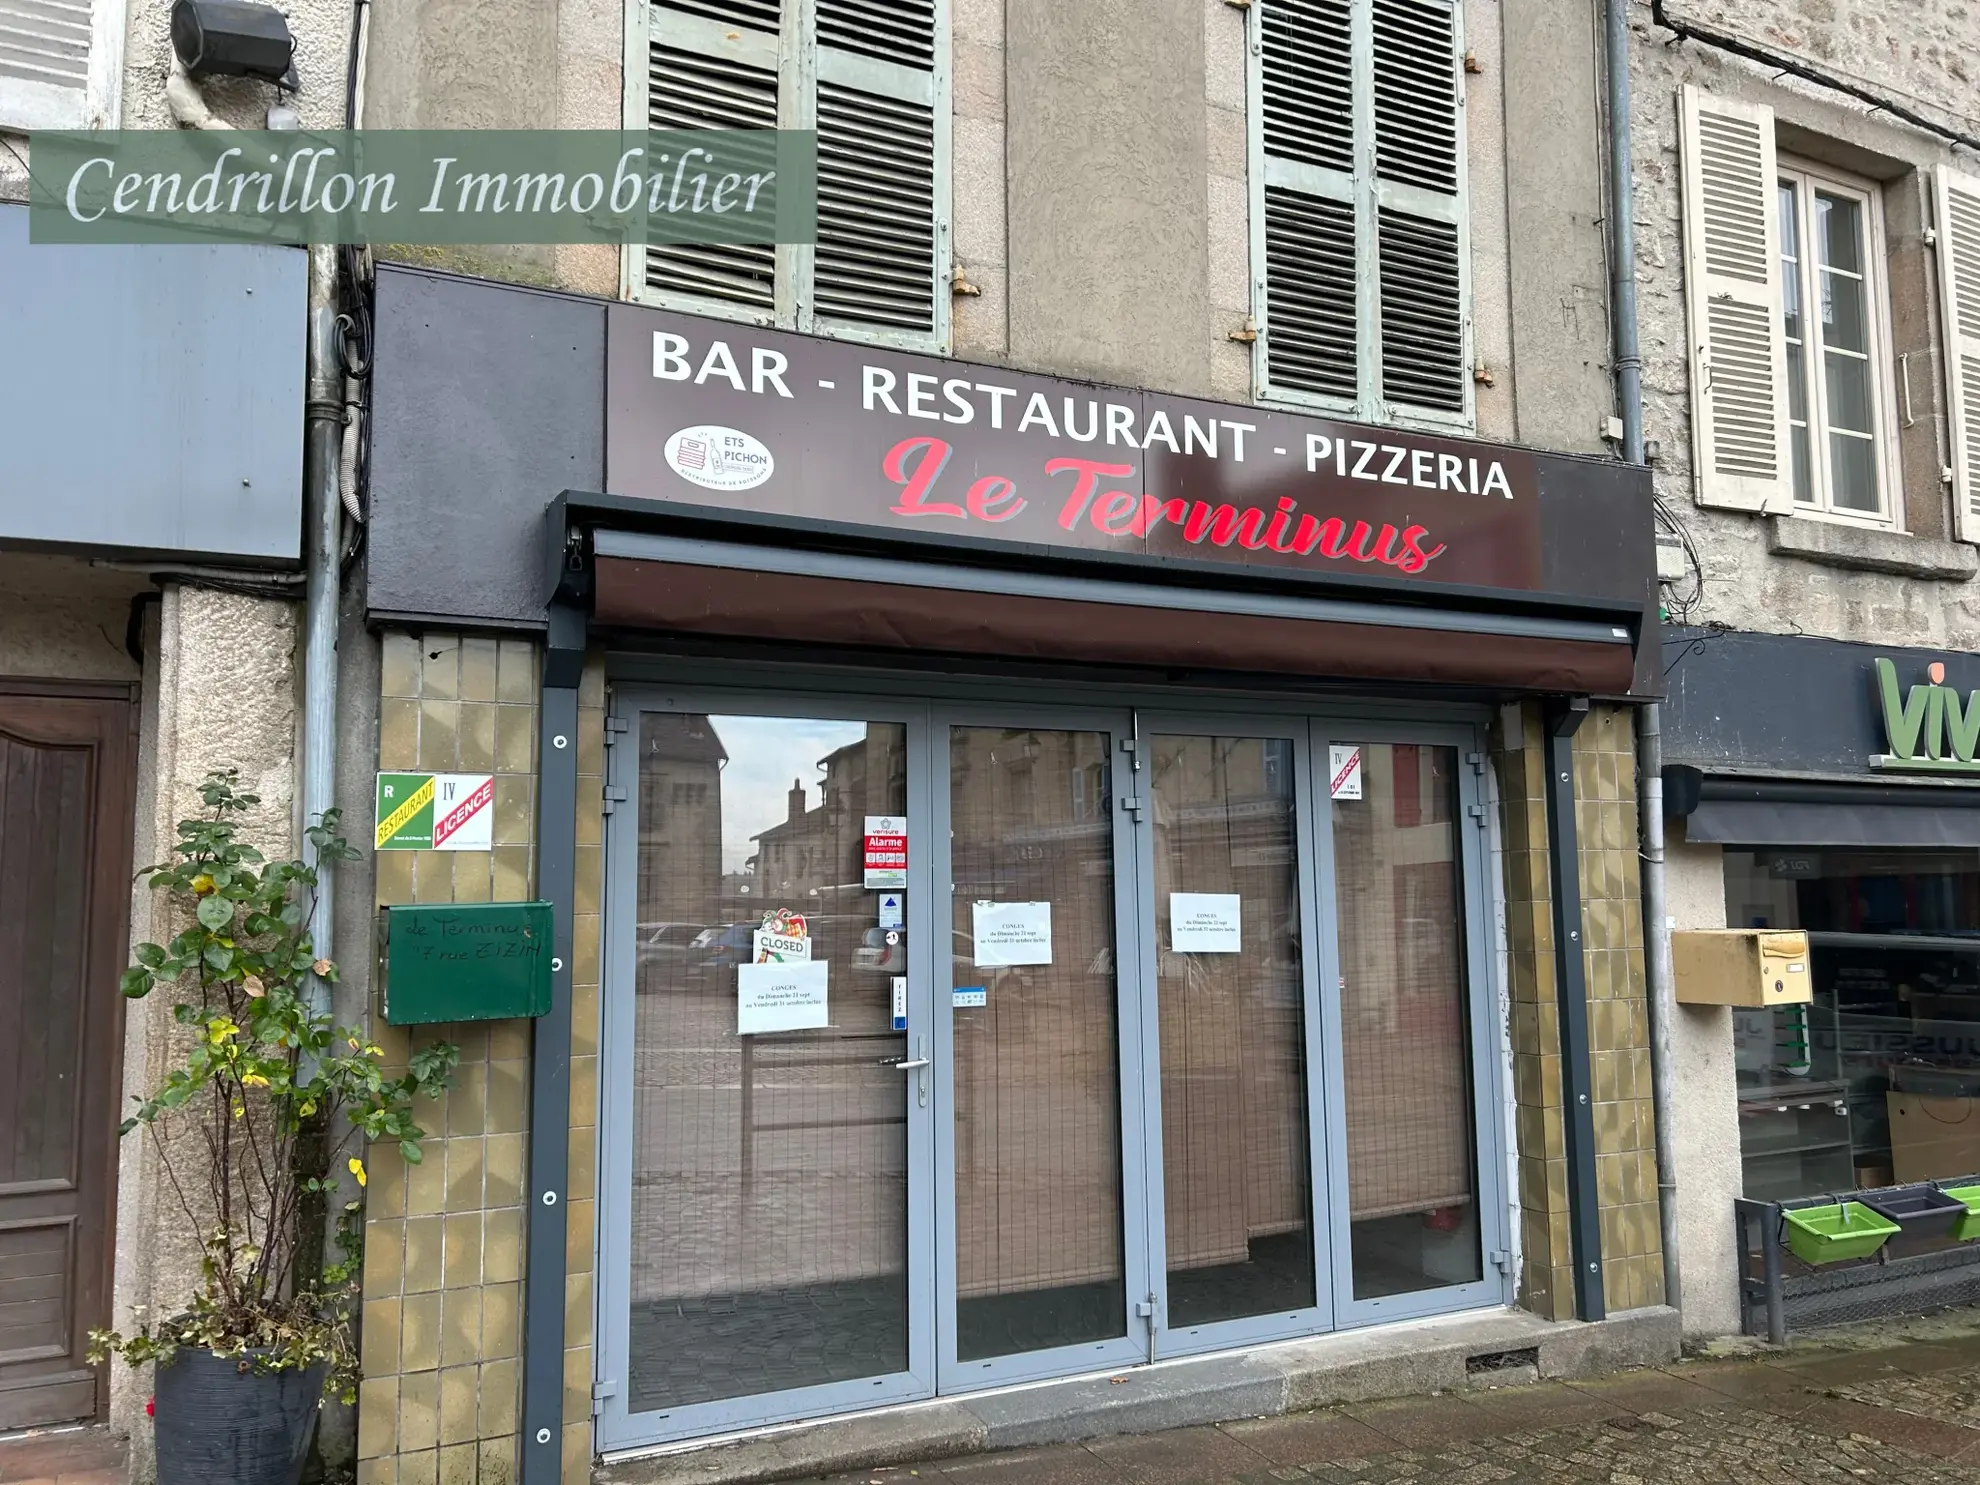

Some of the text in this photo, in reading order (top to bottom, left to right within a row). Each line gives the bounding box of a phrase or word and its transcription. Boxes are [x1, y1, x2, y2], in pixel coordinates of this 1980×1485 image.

[651, 331, 794, 399] BAR
[862, 366, 1256, 463] RESTAURANT
[1306, 433, 1514, 500] PIZZERIA
[724, 436, 745, 448] ETS
[724, 450, 767, 465] PICHON
[882, 436, 1446, 574] Le Terminus
[1331, 751, 1360, 792] LICENCE
[384, 785, 394, 798] R
[443, 782, 456, 801] IV
[376, 781, 435, 840] RESTAURANT
[435, 783, 492, 840] LICENCE
[869, 837, 903, 847] Alarme
[760, 936, 804, 953] CLOSED
